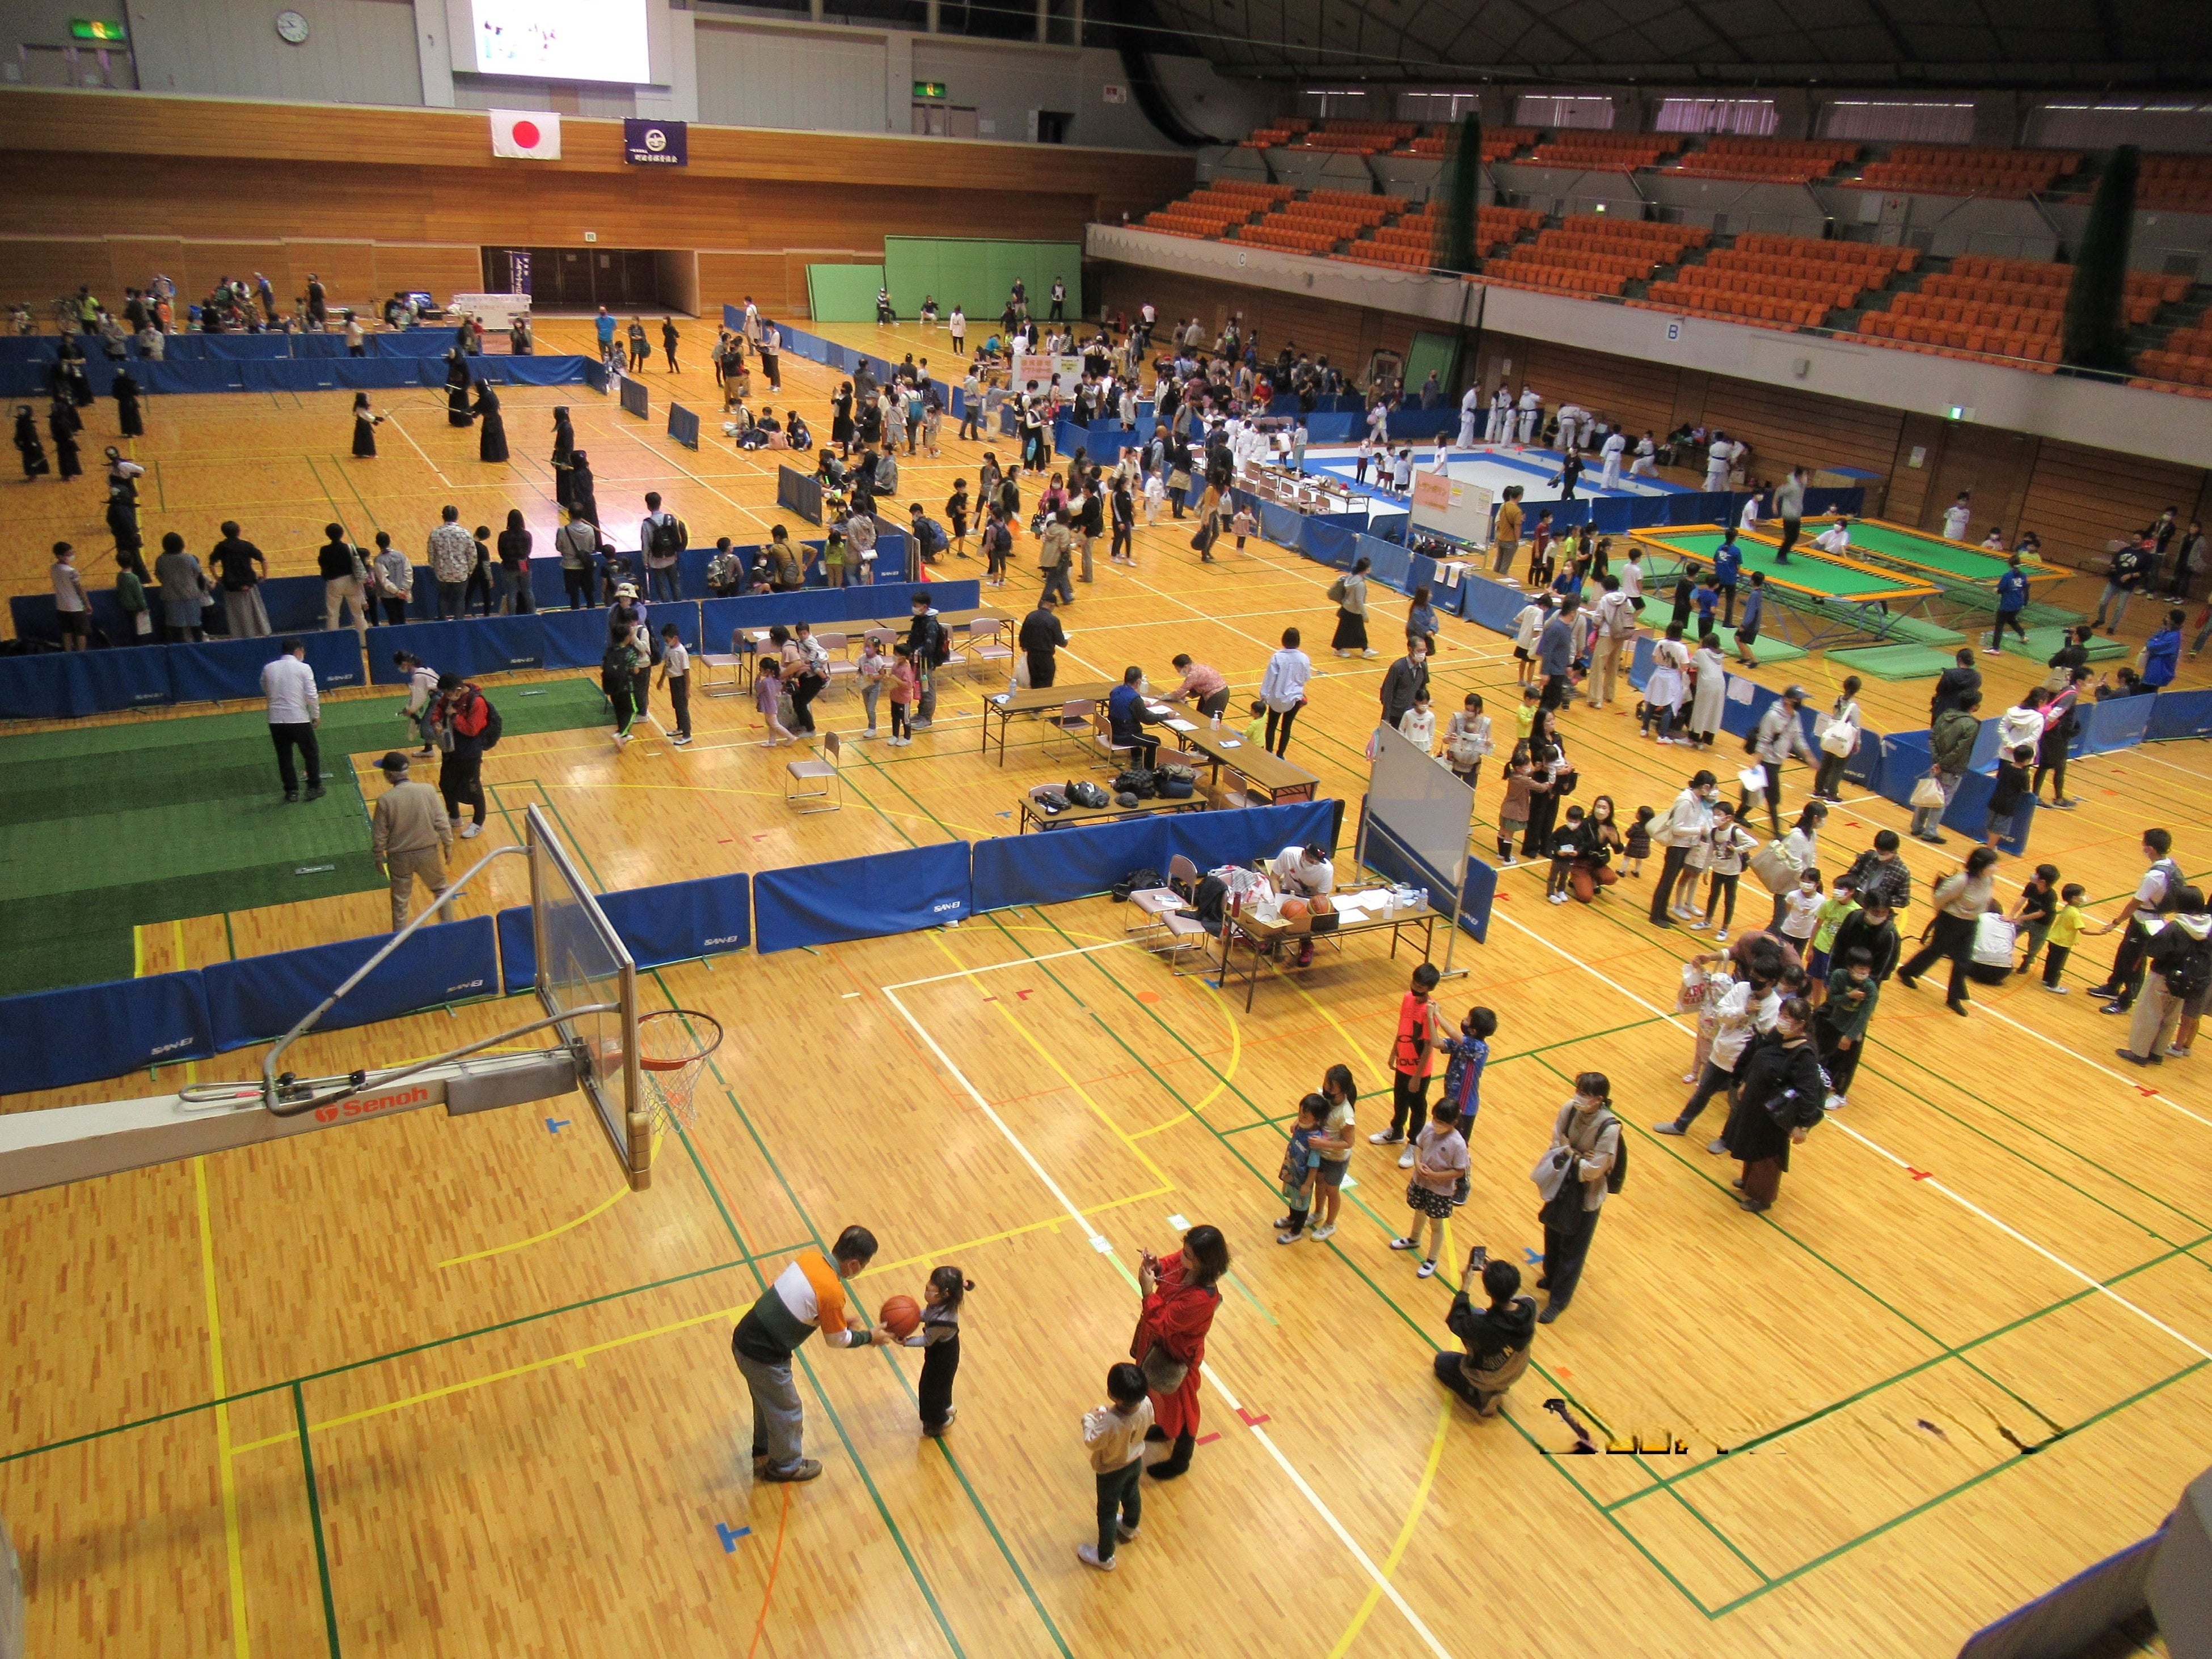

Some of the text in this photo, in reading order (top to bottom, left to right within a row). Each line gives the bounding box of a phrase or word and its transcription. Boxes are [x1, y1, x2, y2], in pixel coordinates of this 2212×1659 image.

[1239, 254, 1245, 264] C
[1668, 325, 1678, 339] B
[343, 1087, 429, 1117] Senoh
